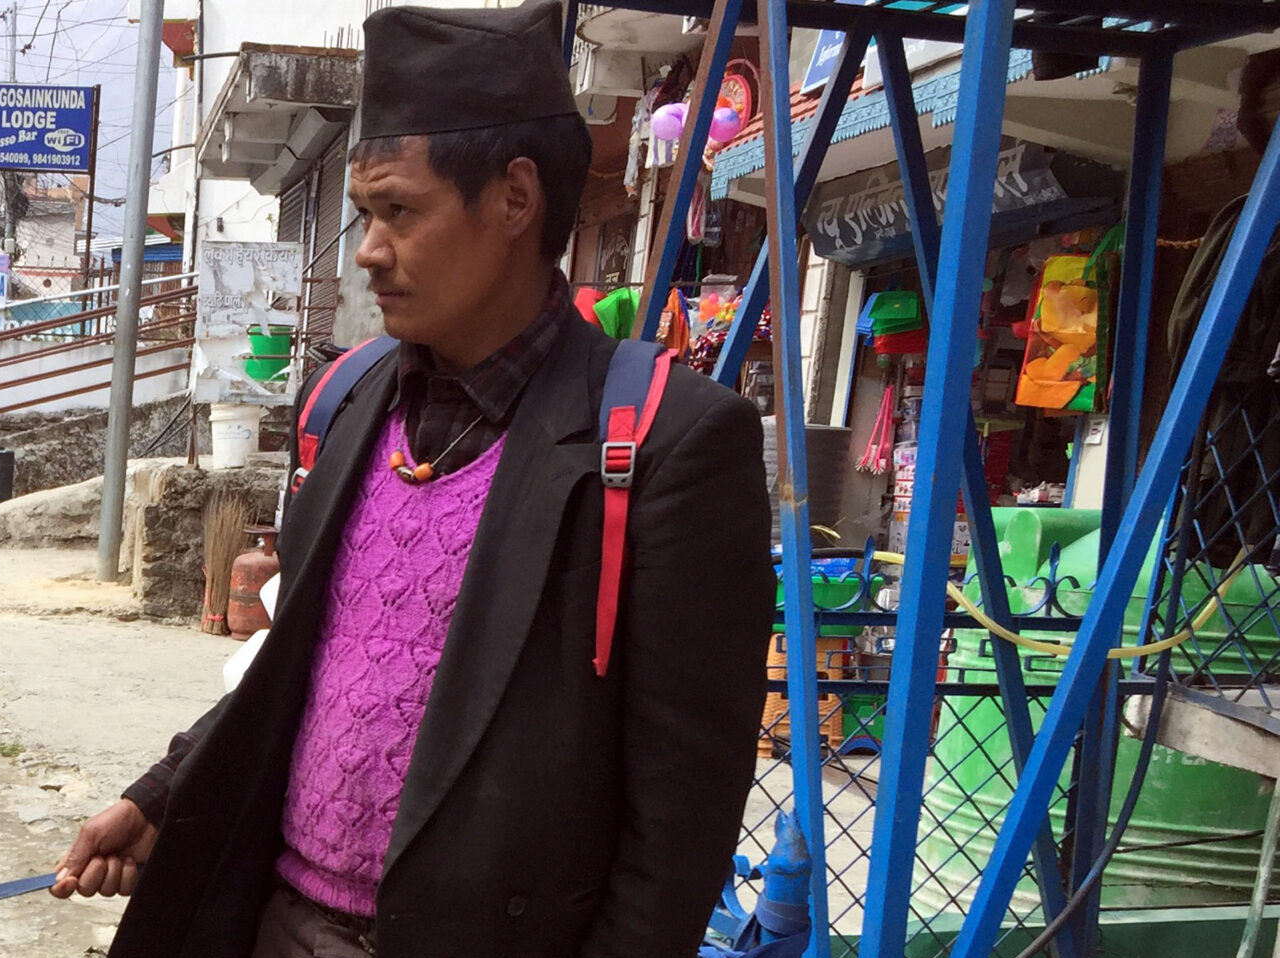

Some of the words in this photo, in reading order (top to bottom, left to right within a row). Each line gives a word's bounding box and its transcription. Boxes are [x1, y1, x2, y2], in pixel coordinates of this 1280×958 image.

[0, 88, 86, 109] GOSAINKUNDA
[2, 110, 56, 129] LODGE
[18, 130, 38, 143] Bar
